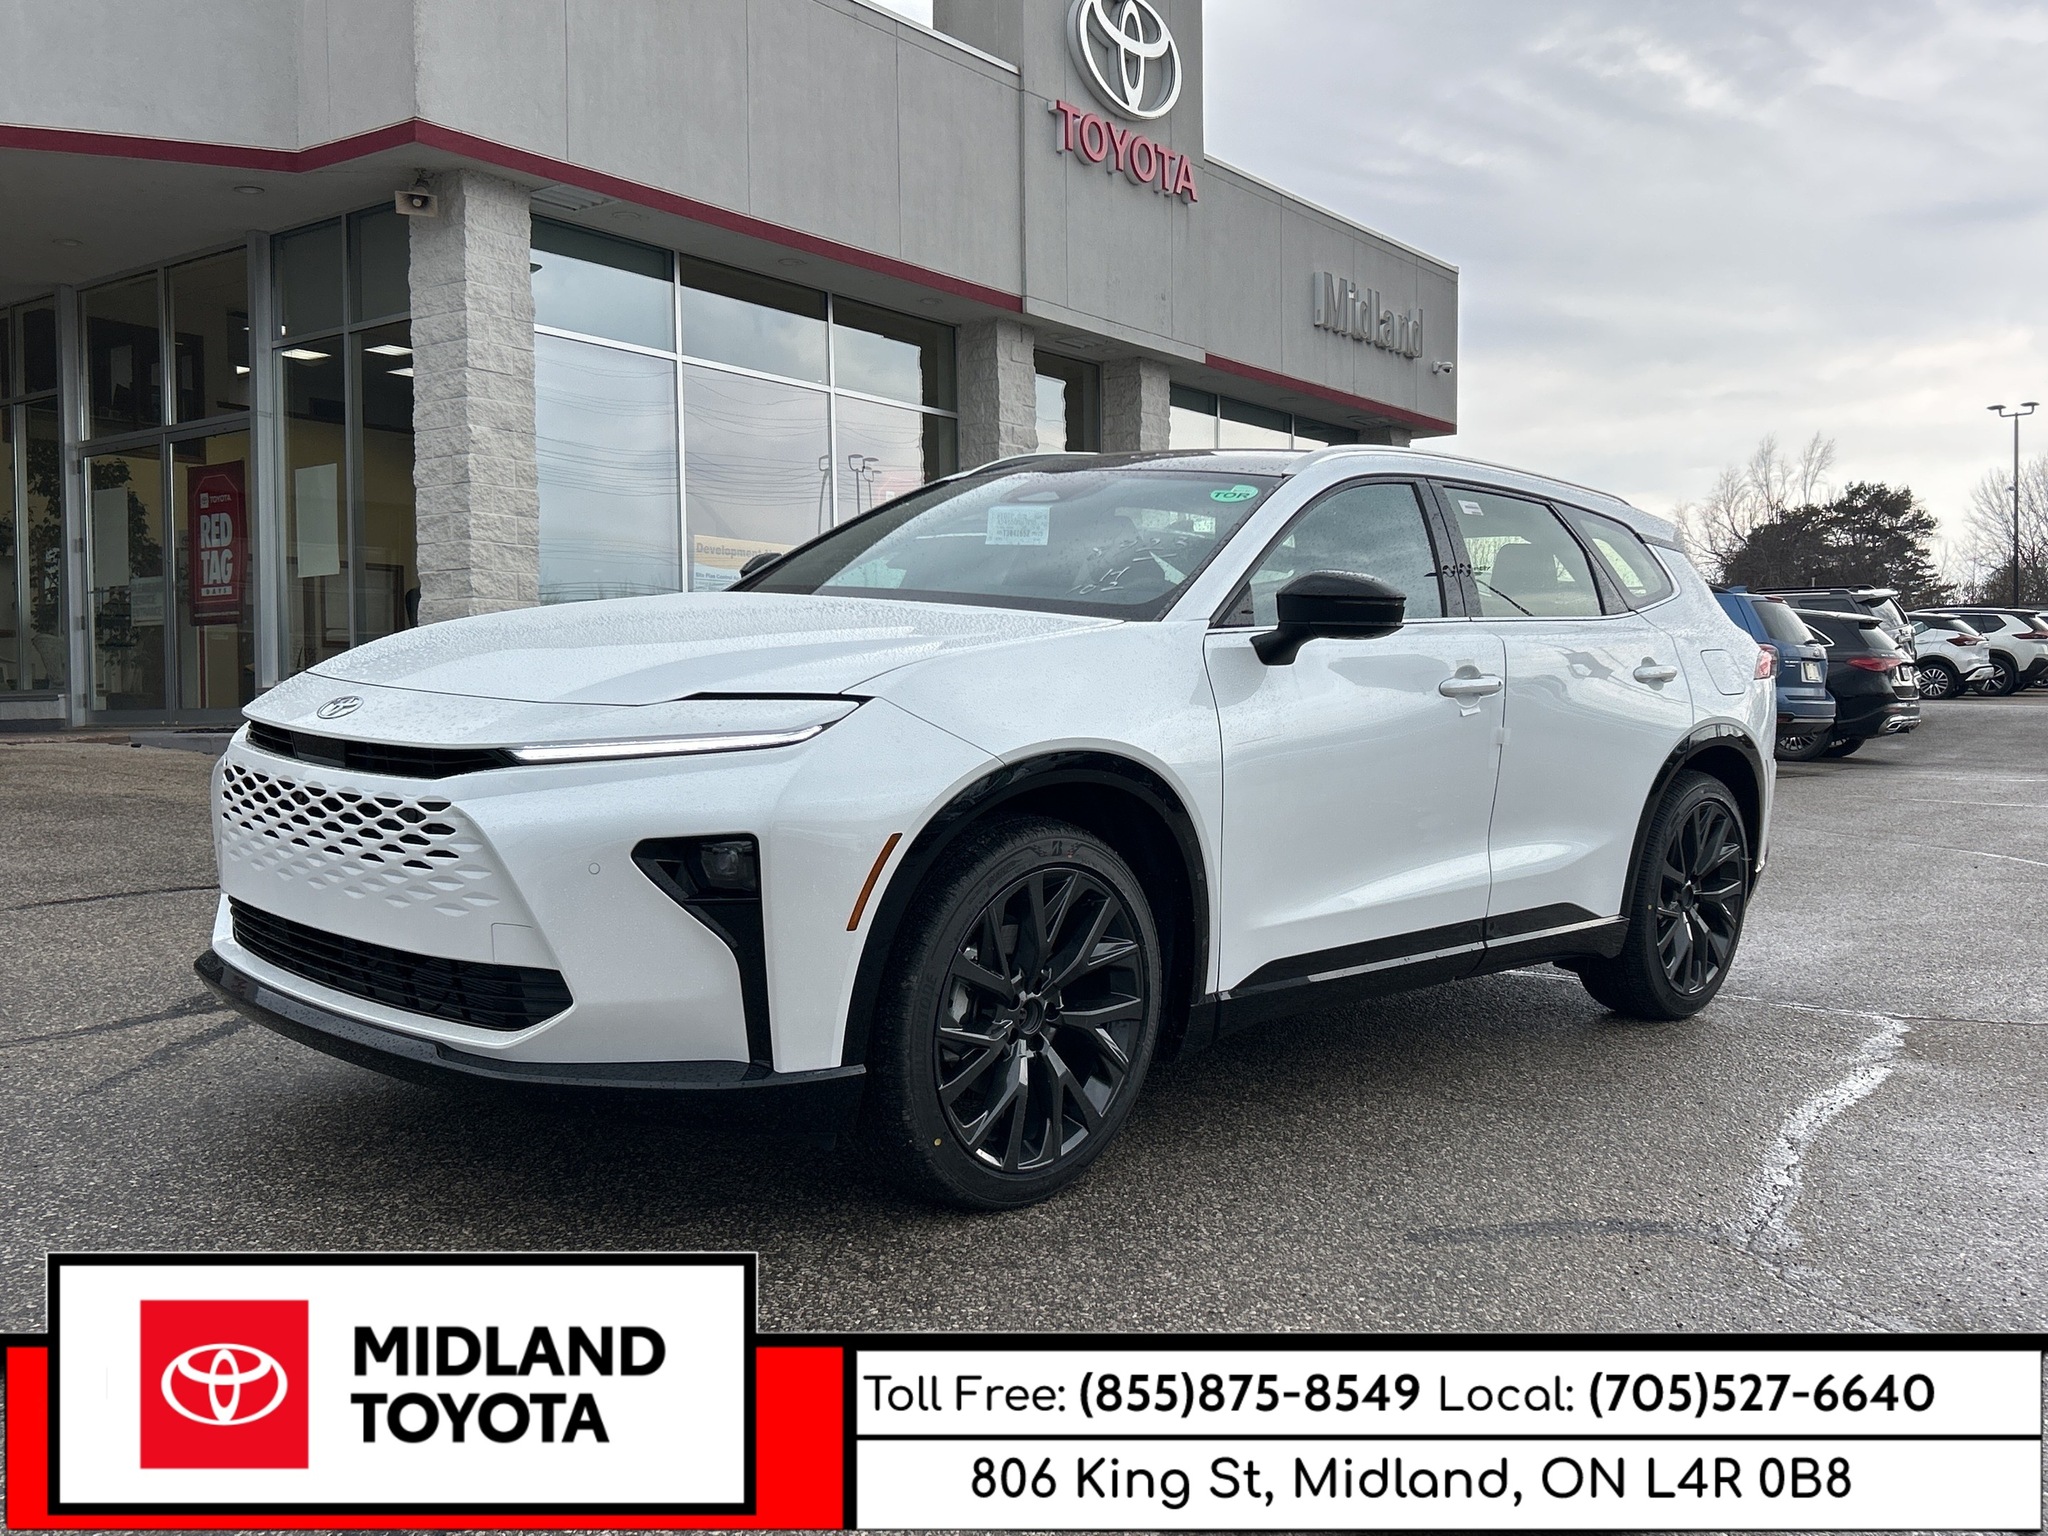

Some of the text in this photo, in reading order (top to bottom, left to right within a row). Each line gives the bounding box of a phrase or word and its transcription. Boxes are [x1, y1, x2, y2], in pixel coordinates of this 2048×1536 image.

[1050, 99, 1198, 203] TOYOTA
[1314, 271, 1423, 359] Midland
[209, 494, 232, 504] TOYOTA
[1214, 491, 1250, 499] TOR
[200, 512, 233, 549] RED
[201, 549, 233, 585] TAG
